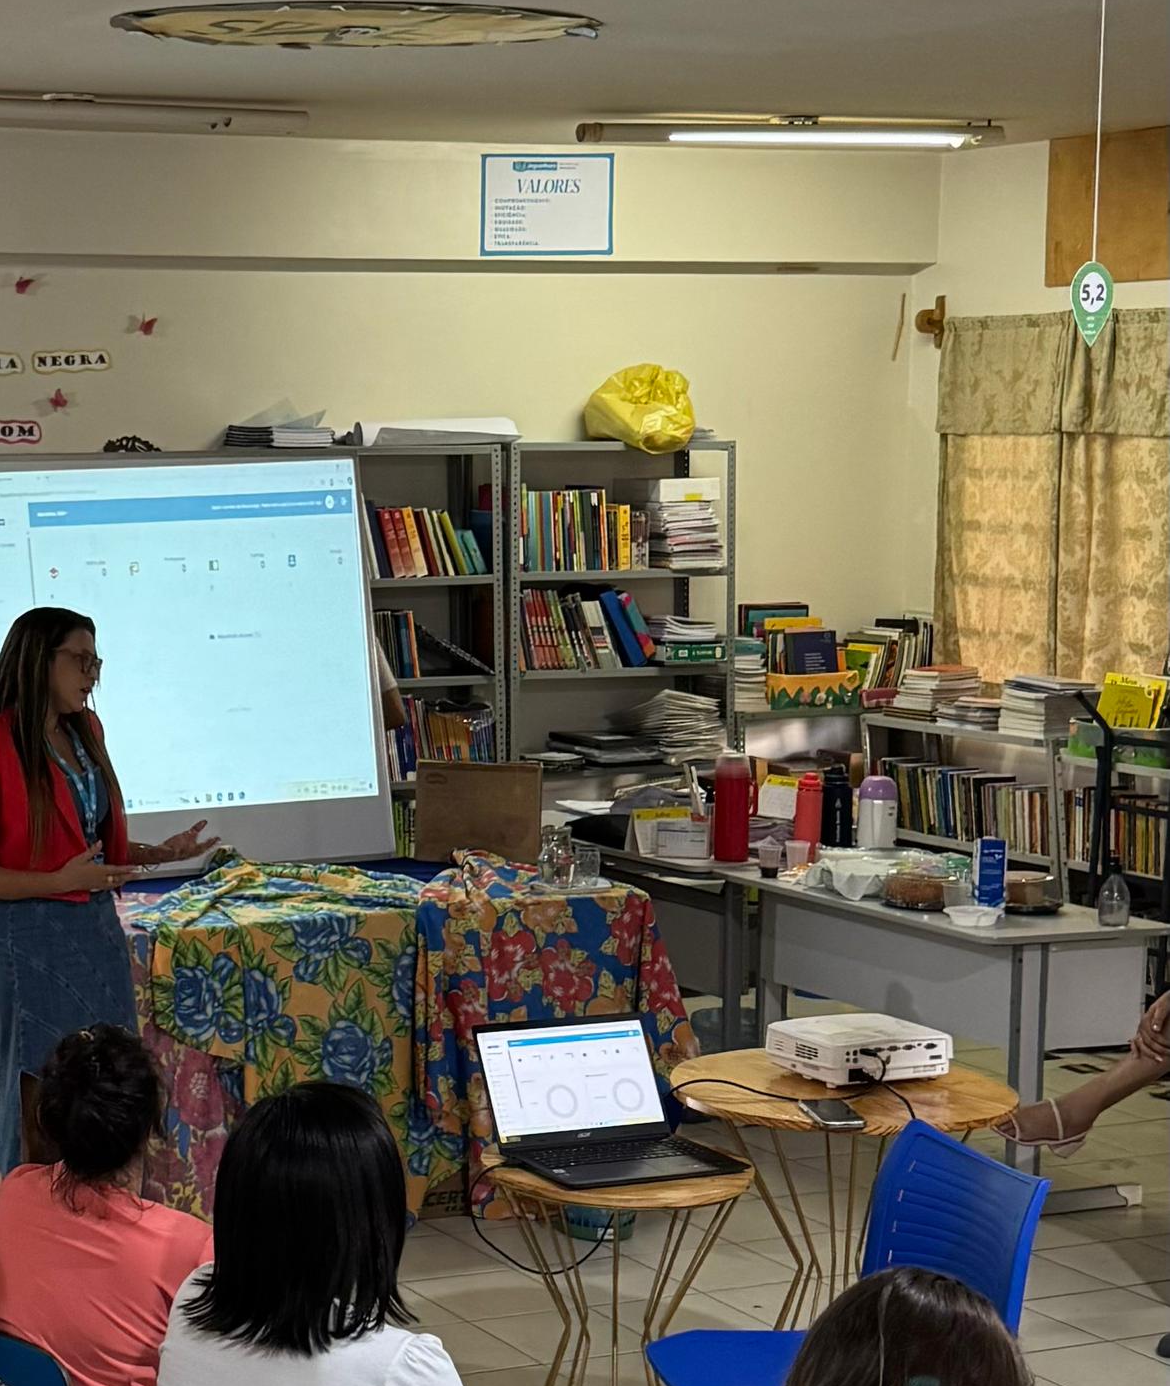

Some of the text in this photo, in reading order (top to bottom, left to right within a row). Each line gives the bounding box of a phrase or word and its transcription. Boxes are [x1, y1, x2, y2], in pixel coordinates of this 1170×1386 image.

[518, 179, 581, 194] VALORES
[1081, 284, 1104, 305] 5,2
[37, 354, 107, 367] NEGRA
